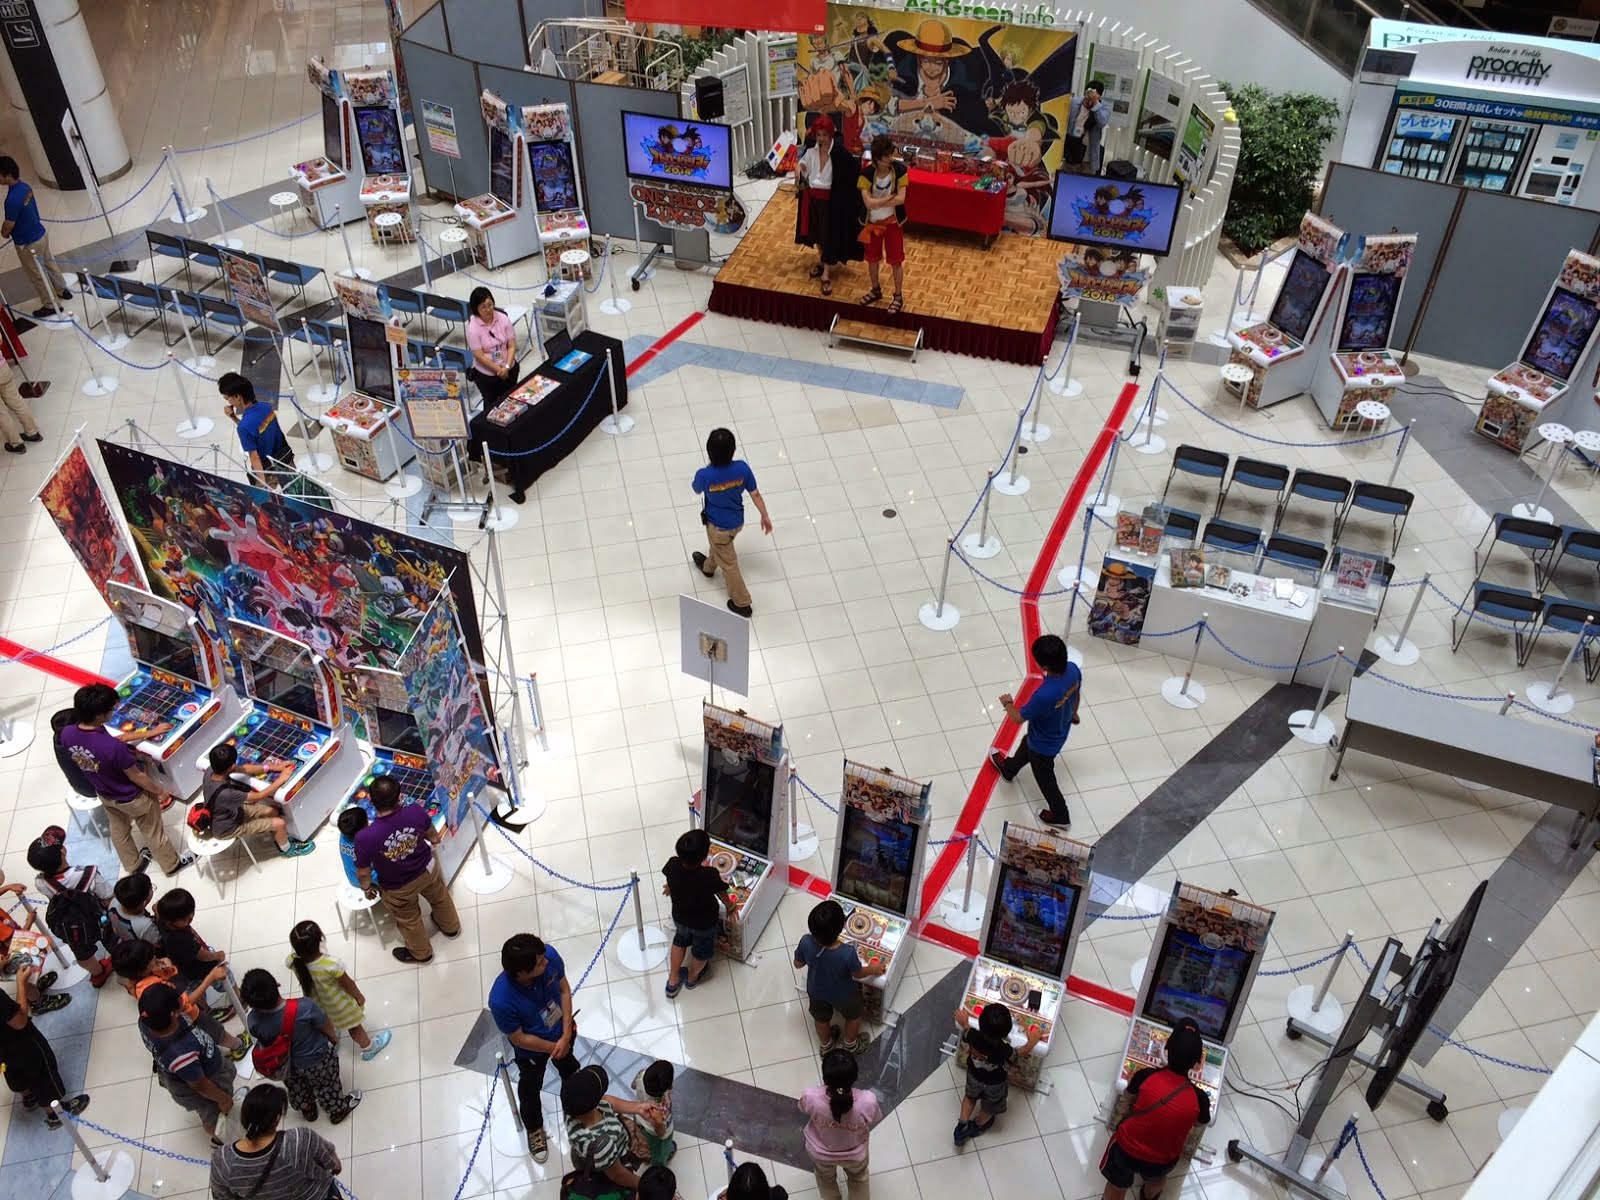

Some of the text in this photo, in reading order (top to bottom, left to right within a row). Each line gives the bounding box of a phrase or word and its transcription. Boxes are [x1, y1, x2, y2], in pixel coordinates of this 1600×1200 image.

[1020, 5, 1055, 25] info
[1488, 45, 1510, 54] Rodan
[1520, 48, 1541, 58] Fields
[1466, 54, 1553, 79] proactiv
[1474, 74, 1541, 87] SOLUTION
[1400, 116, 1452, 130] プレゼント!
[664, 165, 692, 176] 2014
[1093, 227, 1125, 240] 2014
[1081, 289, 1116, 302] 2014
[69, 745, 95, 759] STAFF
[384, 827, 416, 847] STAFF
